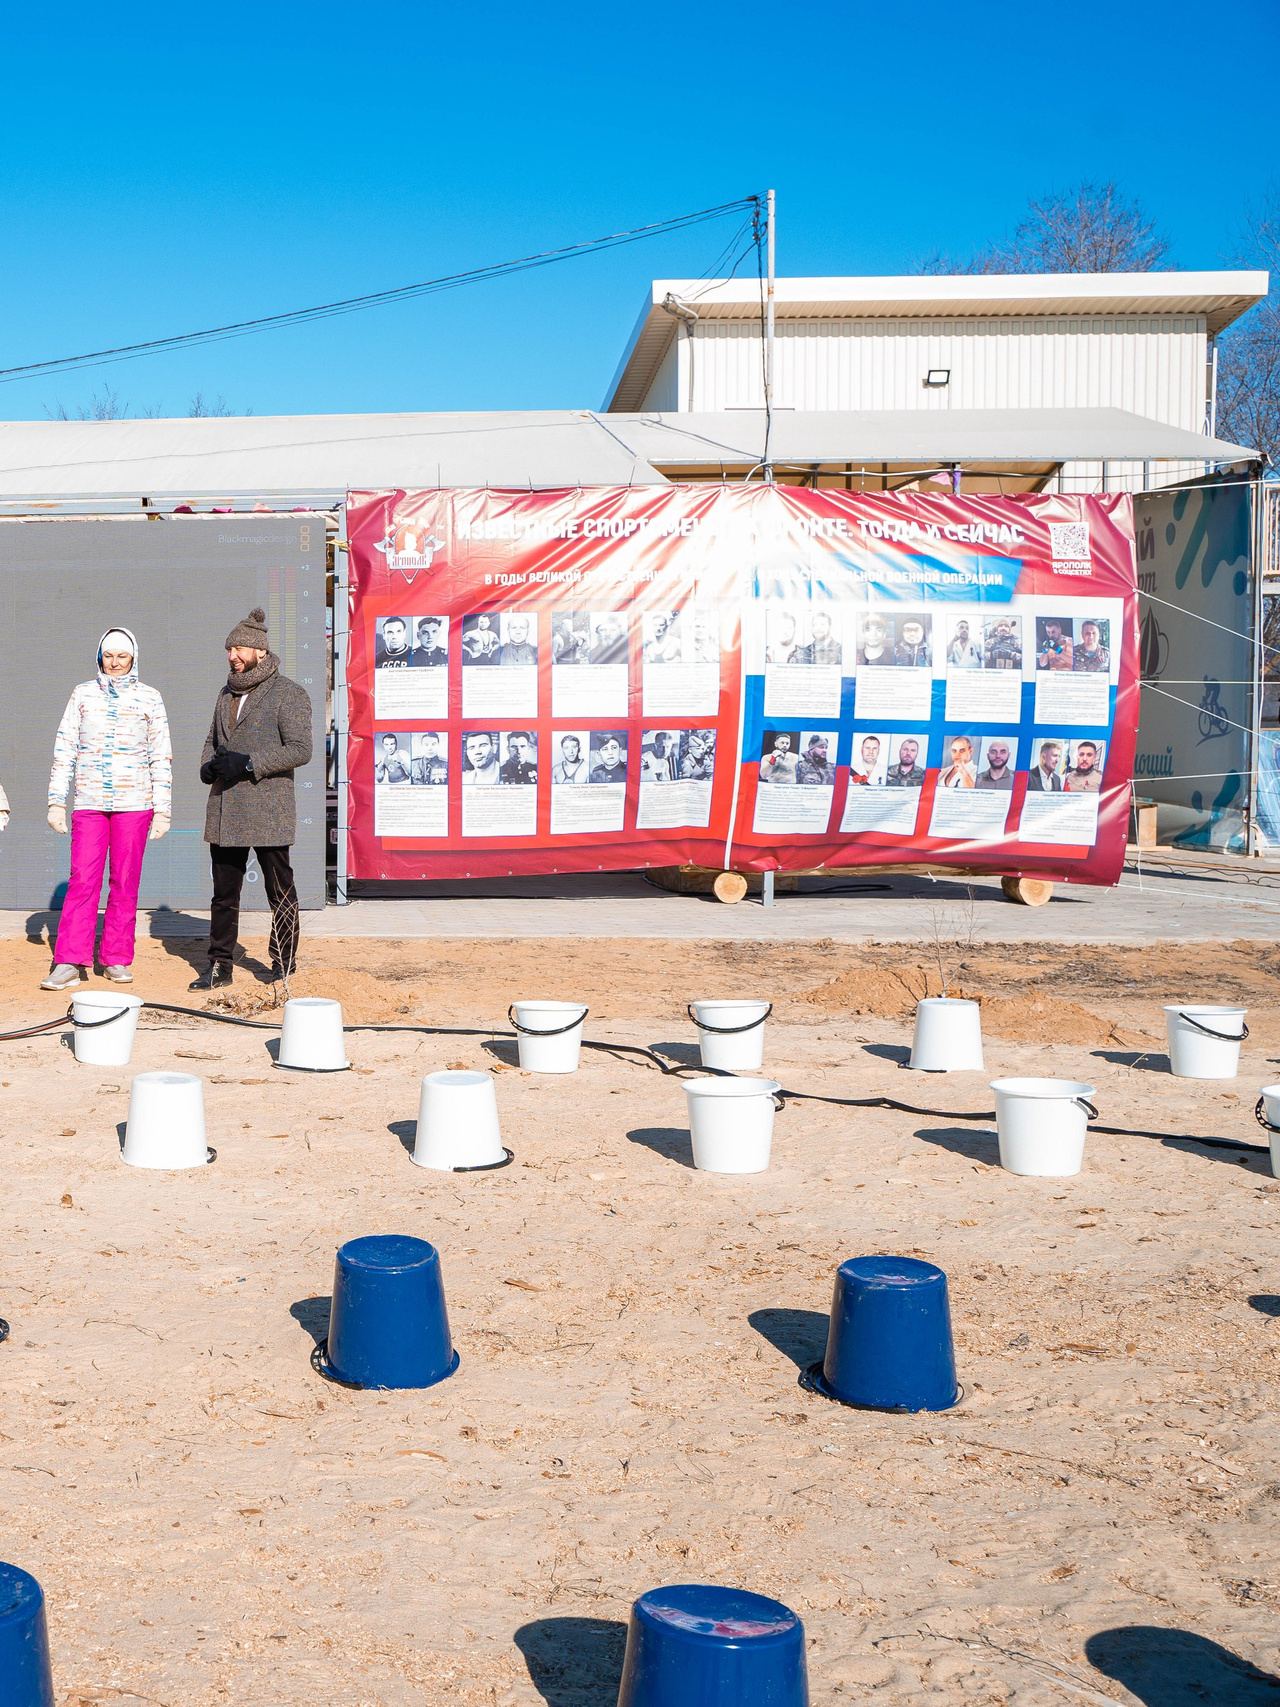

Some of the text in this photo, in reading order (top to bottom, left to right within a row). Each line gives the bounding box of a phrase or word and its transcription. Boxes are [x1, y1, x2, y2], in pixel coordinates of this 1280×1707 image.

[857, 520, 921, 541] ТОГДА
[943, 517, 1025, 543] СЕЙЧАС
[1052, 561, 1092, 570] ЯРОПОЛК
[484, 573, 493, 585] В
[495, 573, 527, 586] ГОДЫ
[529, 569, 582, 584] ВЕЛИКОЙ
[887, 570, 940, 584] ВОЕННОЙ
[942, 573, 1003, 586] ОПЕРАЦИИ
